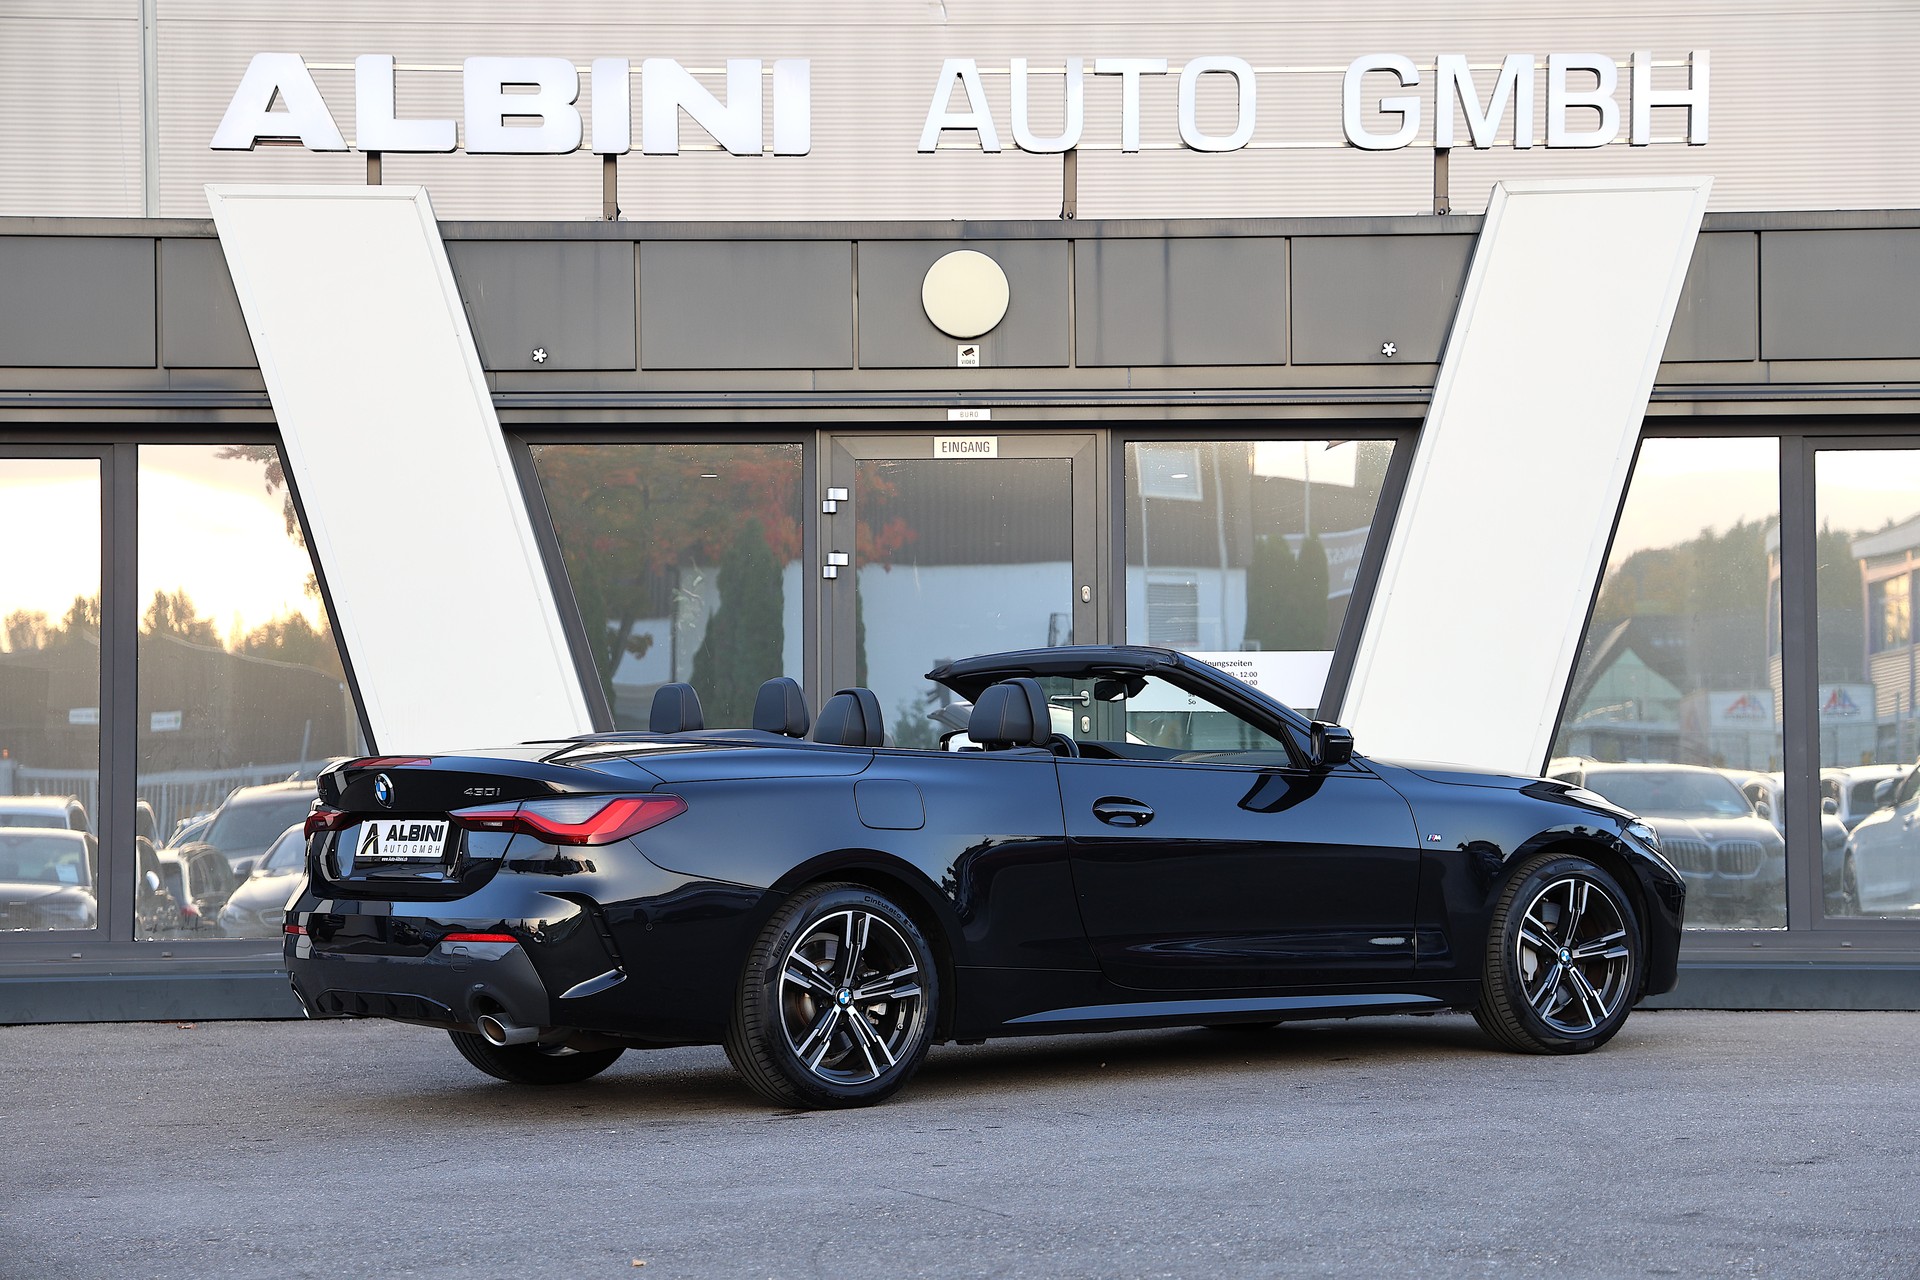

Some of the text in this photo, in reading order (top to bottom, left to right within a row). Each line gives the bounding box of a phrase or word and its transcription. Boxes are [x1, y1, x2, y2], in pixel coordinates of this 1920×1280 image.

[209, 49, 1711, 157] ALBINI AUTO GMBH
[941, 441, 990, 453] EINGANG
[385, 824, 445, 842] ALBINI
[383, 844, 441, 854] AUTO GMBH
